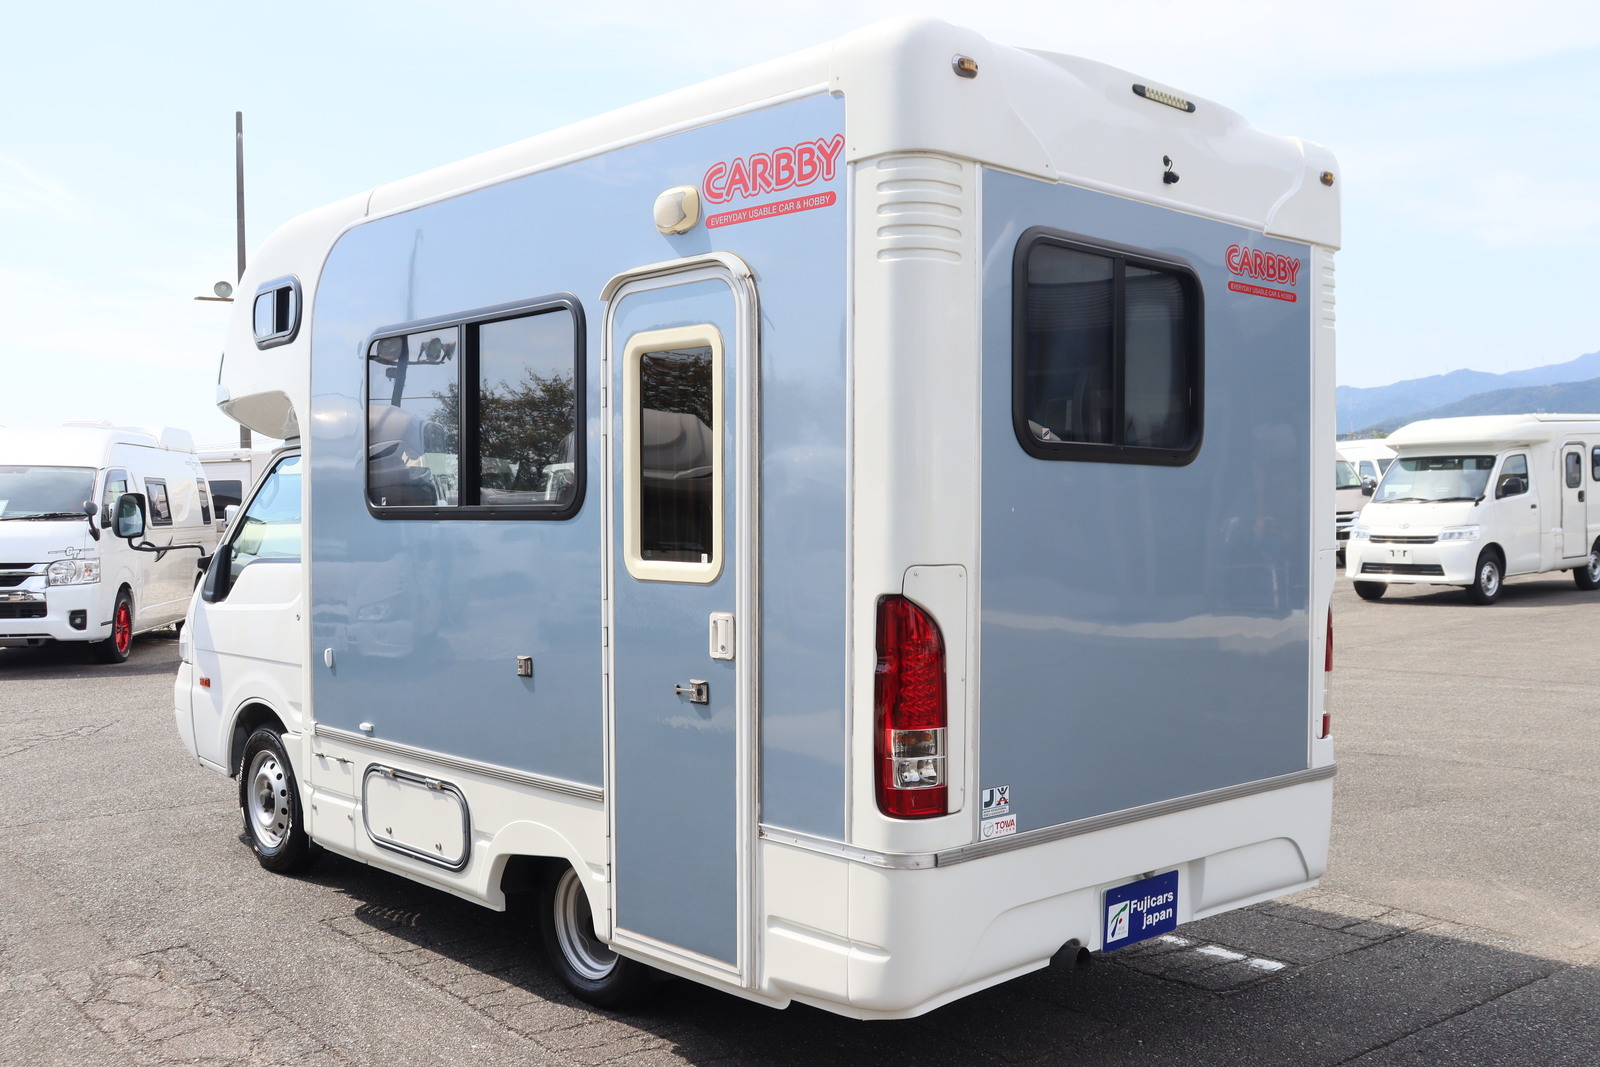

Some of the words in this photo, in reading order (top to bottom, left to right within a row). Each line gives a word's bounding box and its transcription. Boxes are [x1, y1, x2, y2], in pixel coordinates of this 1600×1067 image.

[702, 133, 845, 204] CARBBY
[710, 210, 747, 226] EVERYDAY
[748, 205, 777, 219] USABLE
[778, 202, 794, 213] CAR
[796, 200, 801, 209] &
[803, 194, 831, 208] HOBBY
[1225, 244, 1300, 287] CARBBY
[1230, 283, 1252, 292] EVERYDAY
[1252, 287, 1268, 295] USABLE
[1281, 292, 1295, 300] HOBBY
[994, 819, 1015, 830] TOWA
[1130, 891, 1174, 914] Fujicars
[1142, 907, 1173, 930] japan
